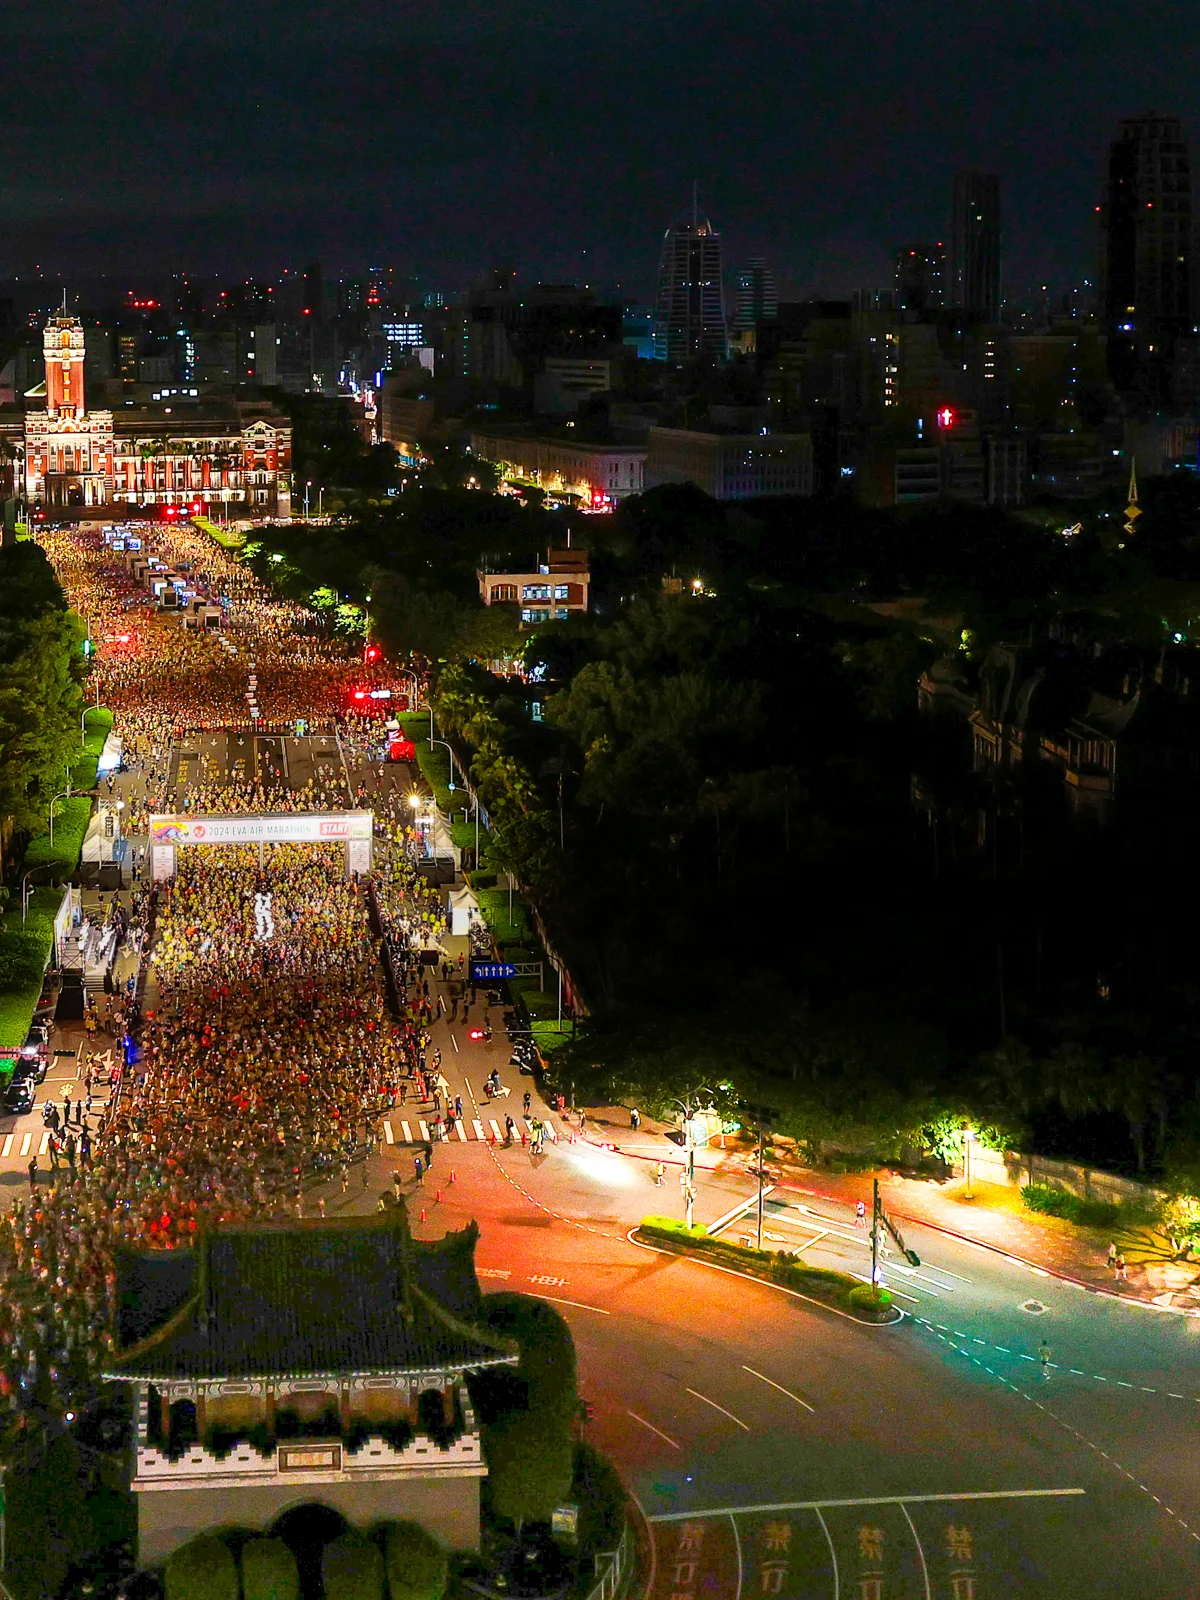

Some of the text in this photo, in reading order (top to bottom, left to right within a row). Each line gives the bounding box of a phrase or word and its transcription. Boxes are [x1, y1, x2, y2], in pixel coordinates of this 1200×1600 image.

[208, 826, 230, 837] 2024
[232, 825, 248, 836] EVA
[250, 825, 265, 836] AIR
[321, 822, 349, 835] START
